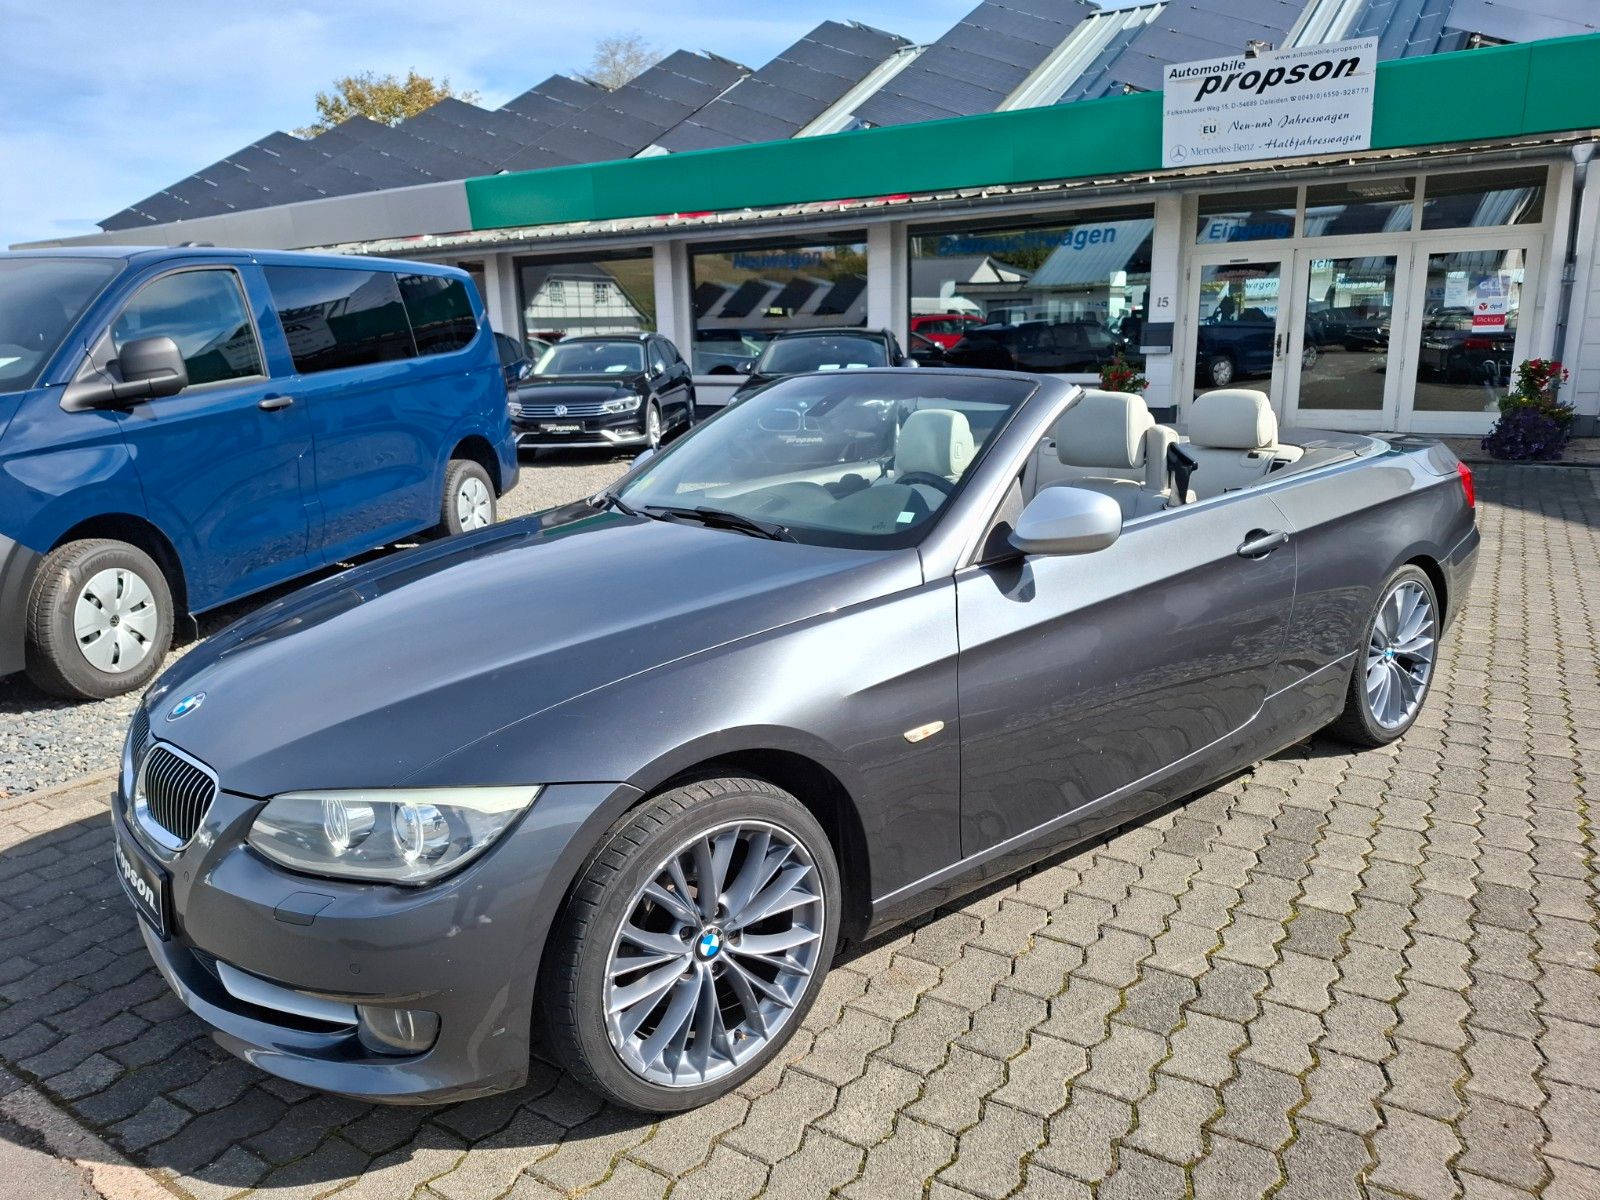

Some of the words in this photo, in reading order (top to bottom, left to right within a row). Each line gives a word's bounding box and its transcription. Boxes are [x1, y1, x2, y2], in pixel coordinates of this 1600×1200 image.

[1274, 42, 1373, 61] www.automobile-propson.de
[1169, 59, 1246, 79] Automobile
[1193, 56, 1361, 102] propson
[1206, 105, 1220, 113] Weg
[1259, 96, 1288, 106] Daleiden
[1278, 112, 1350, 129] Jahreswagen
[1203, 125, 1217, 134] EU
[1190, 143, 1255, 156] Mercedes-Benz
[1157, 296, 1169, 308] 15
